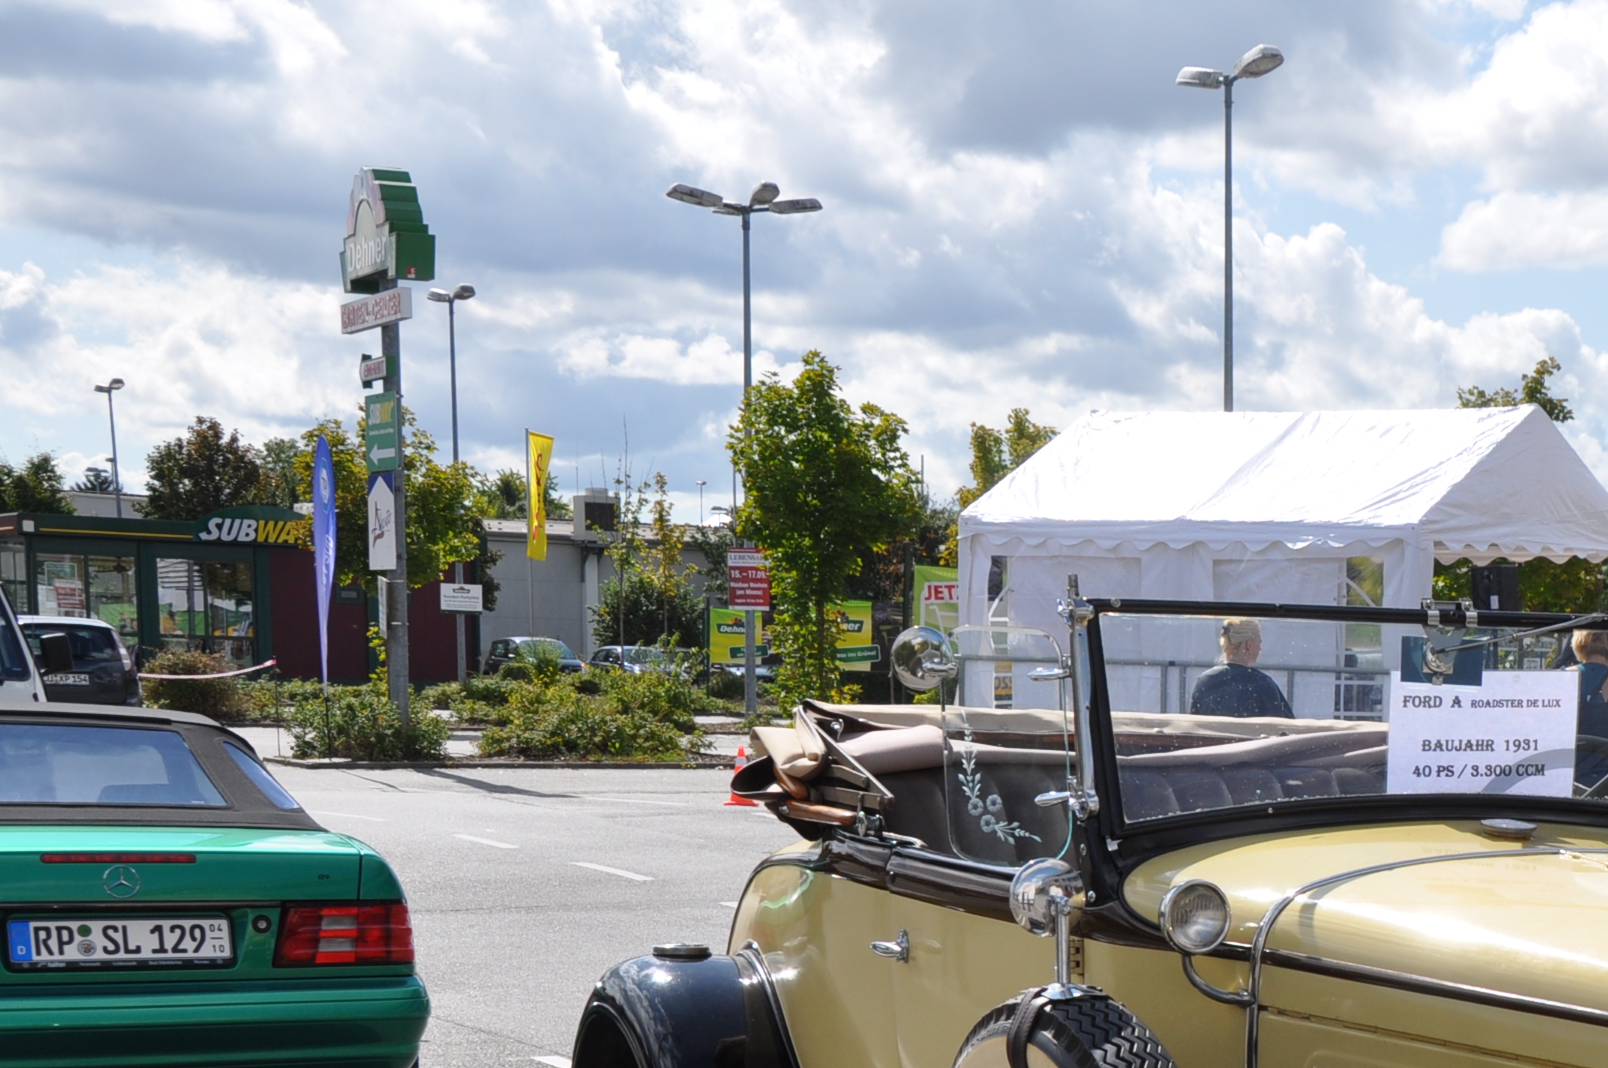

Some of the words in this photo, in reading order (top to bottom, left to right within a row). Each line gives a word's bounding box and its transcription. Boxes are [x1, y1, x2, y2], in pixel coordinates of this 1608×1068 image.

[349, 236, 387, 272] Dehner
[199, 517, 297, 543] SUBWA
[925, 584, 959, 601] JET
[720, 624, 745, 633] Dehn
[1402, 695, 1443, 709] FORD
[1450, 695, 1463, 709] A
[1471, 698, 1524, 709] ROADSTER
[1526, 699, 1540, 709] DE
[1541, 699, 1562, 709] LUX
[1421, 738, 1495, 752] BAUJAHR
[1504, 738, 1540, 752] 1931
[1412, 765, 1432, 778] 40
[1435, 764, 1455, 778] PS
[1471, 763, 1512, 777] 3.300
[1515, 763, 1546, 777] CCM
[33, 925, 75, 956] RP
[102, 924, 142, 955] SL
[149, 923, 207, 954] 129
[209, 923, 224, 933] 04
[17, 945, 26, 955] D
[211, 944, 225, 954] 10
